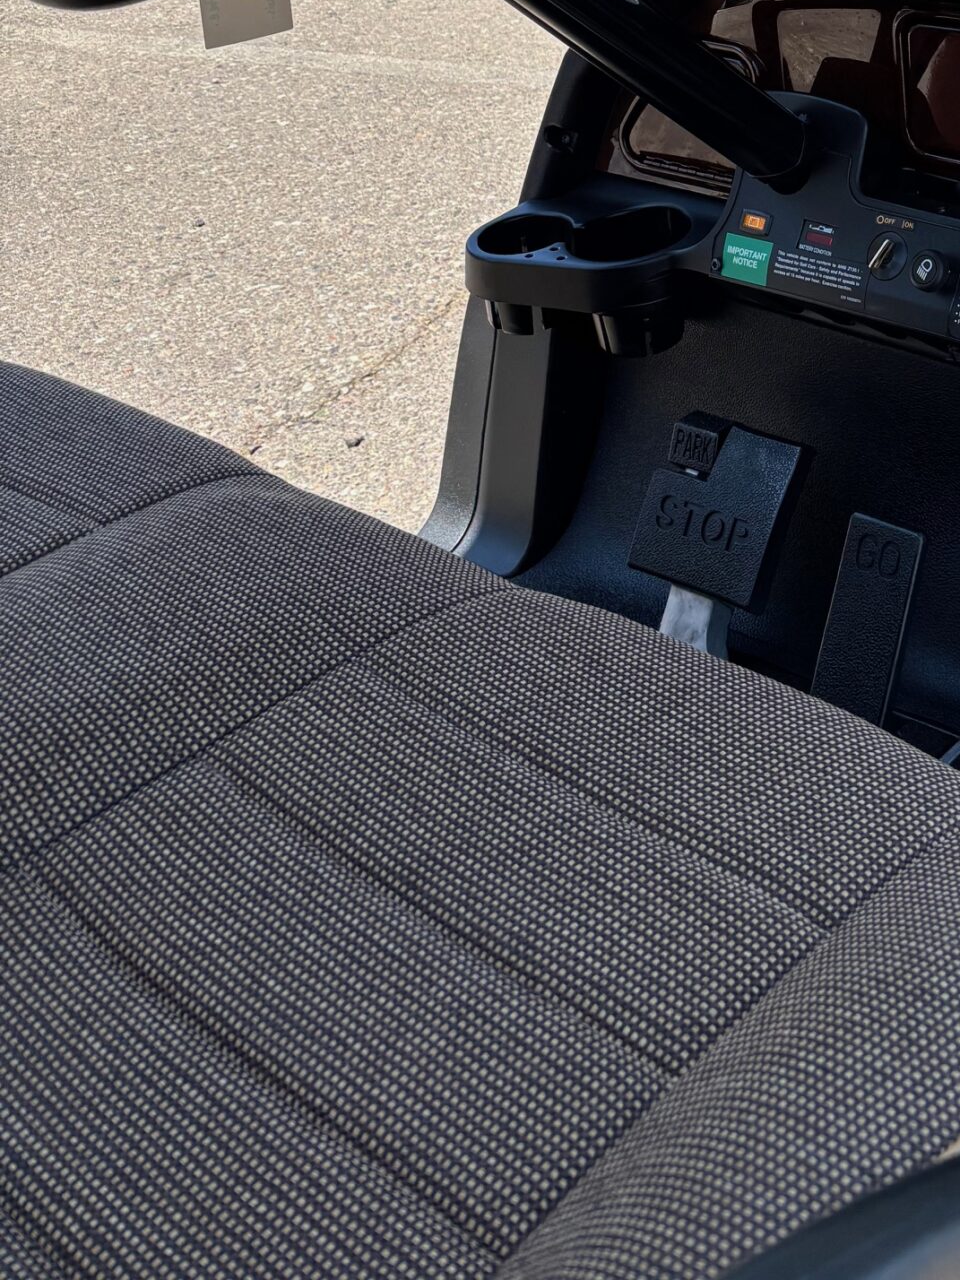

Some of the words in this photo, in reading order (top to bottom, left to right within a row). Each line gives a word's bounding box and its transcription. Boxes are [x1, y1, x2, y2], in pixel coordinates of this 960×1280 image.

[727, 245, 767, 261] IMPORTANT
[733, 256, 758, 269] NOTICE
[674, 429, 712, 464] PARK
[656, 495, 749, 552] STOP
[856, 534, 900, 579] GO
